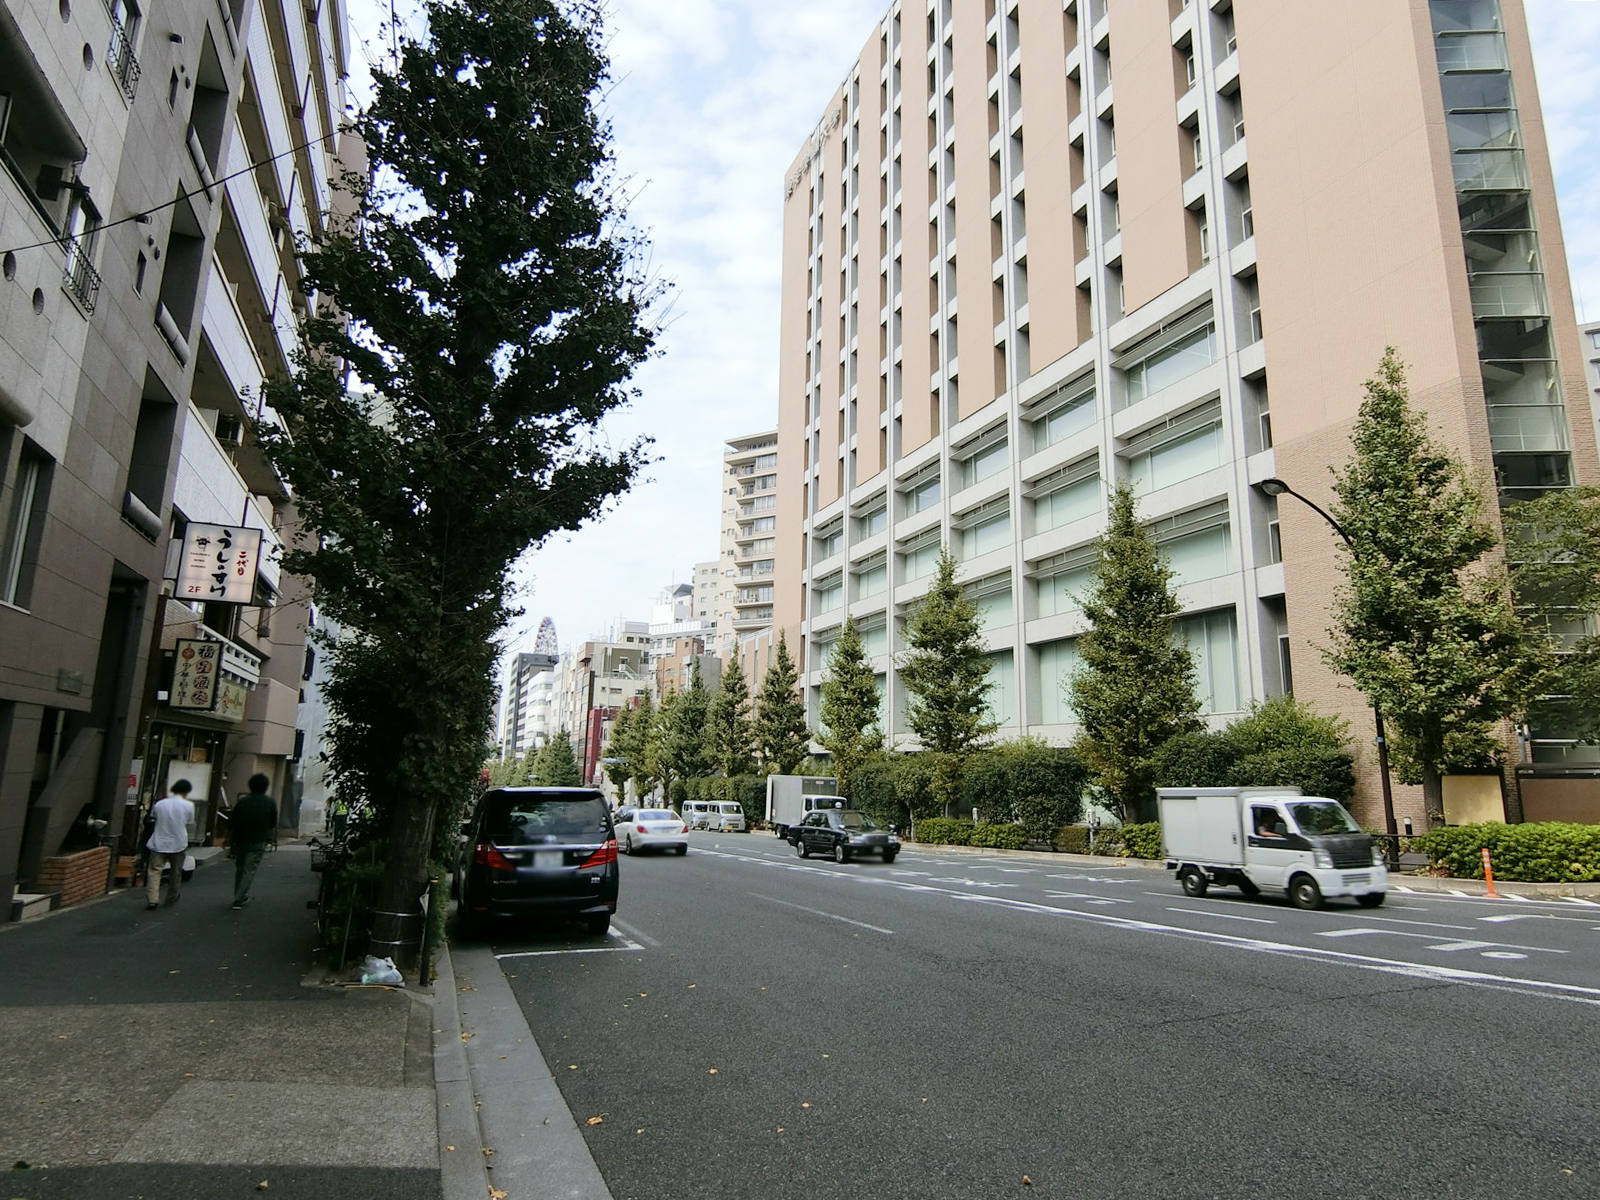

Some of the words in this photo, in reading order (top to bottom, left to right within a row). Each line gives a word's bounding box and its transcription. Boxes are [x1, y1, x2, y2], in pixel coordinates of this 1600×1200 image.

[210, 529, 232, 597] うしのすけ
[236, 551, 249, 576] 二代目
[187, 585, 202, 594] 2F
[192, 645, 214, 705] 福星酒家
